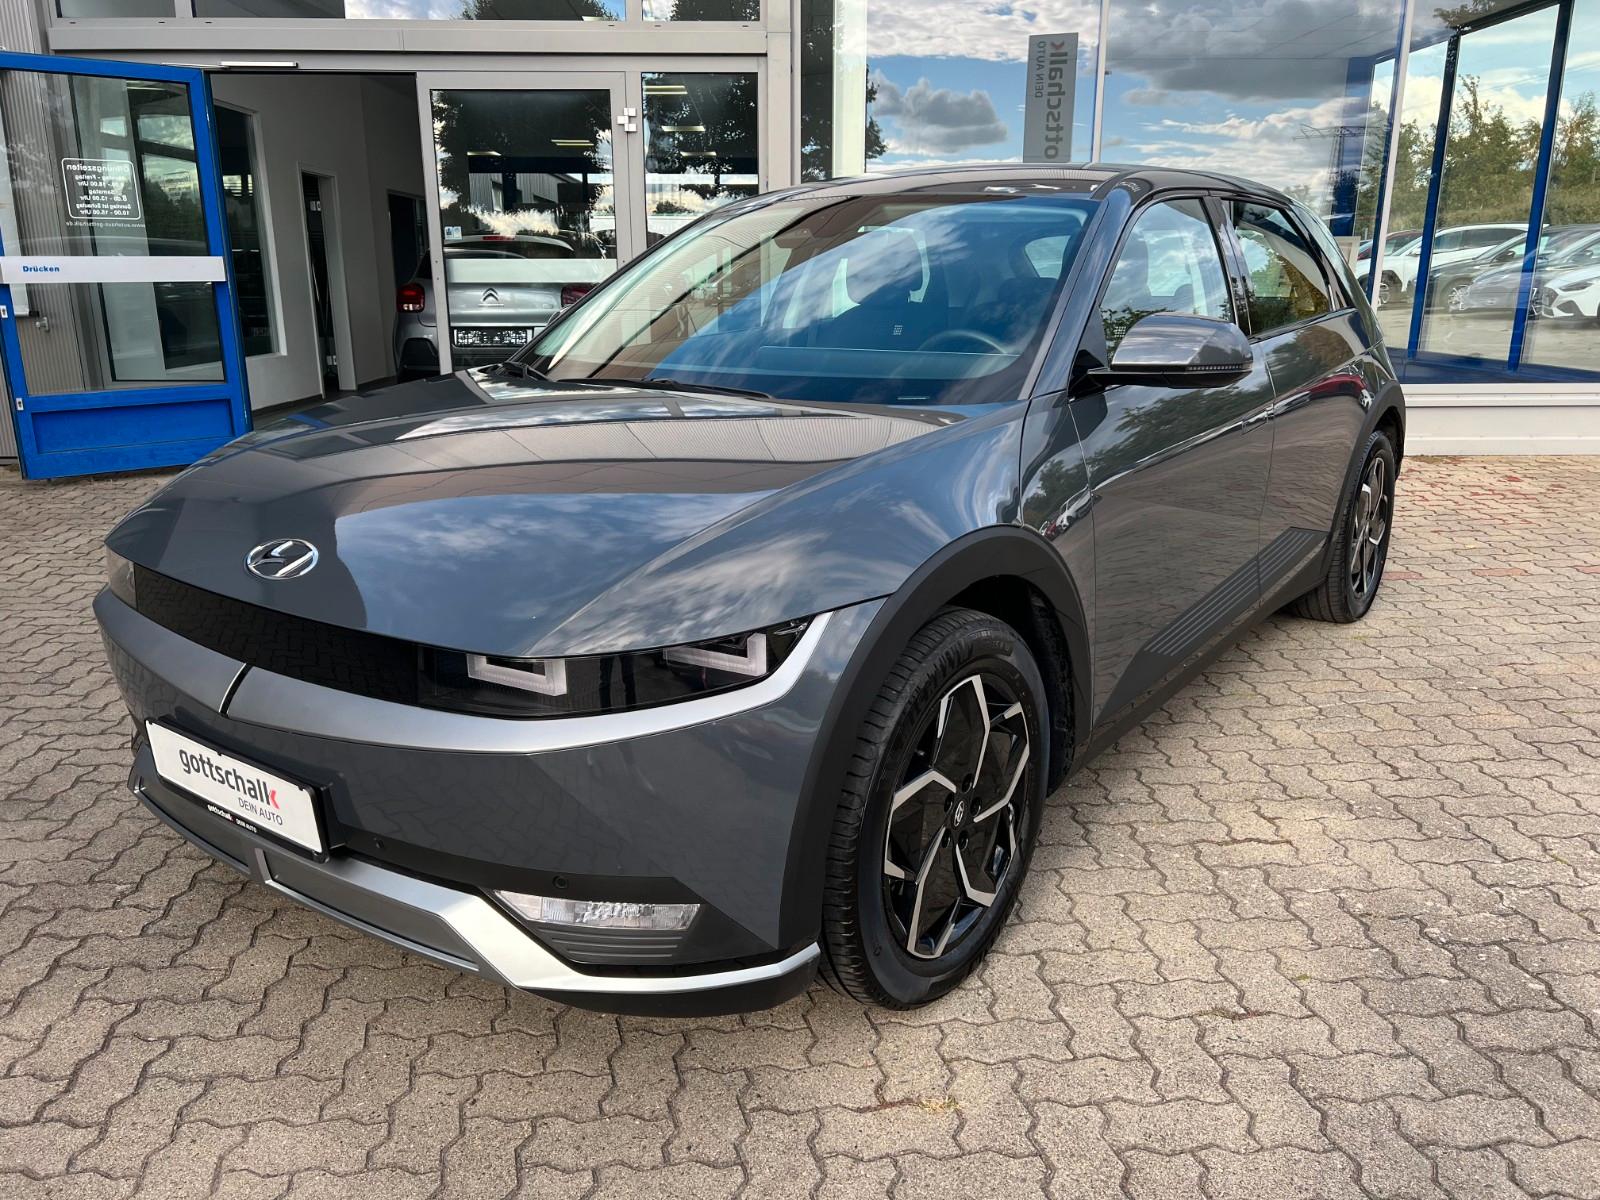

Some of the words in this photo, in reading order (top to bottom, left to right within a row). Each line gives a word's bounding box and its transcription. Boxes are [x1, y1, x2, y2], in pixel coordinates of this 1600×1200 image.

[22, 265, 60, 273] Drücken
[179, 749, 280, 810] gottschalk
[238, 797, 258, 816] DEIN
[259, 808, 283, 826] AUTO
